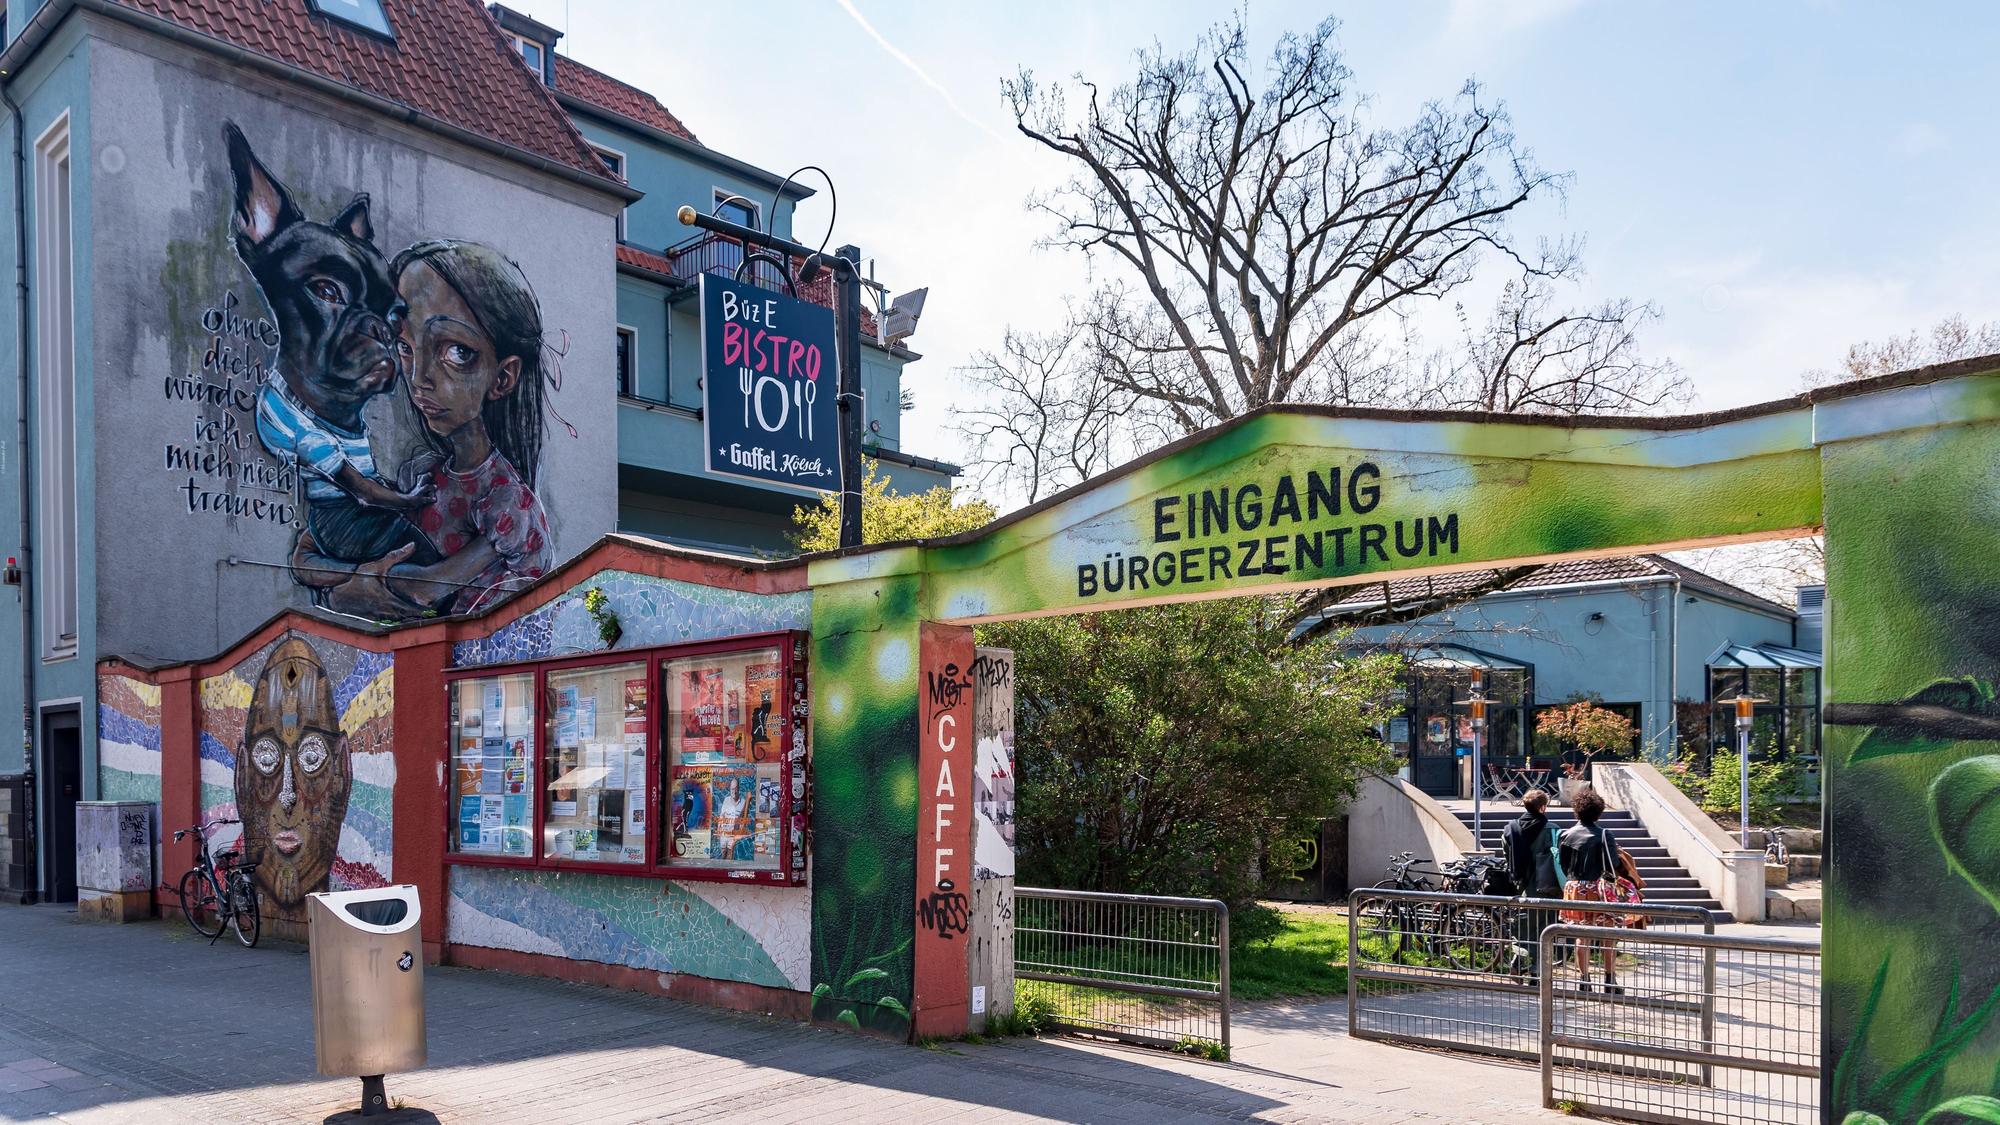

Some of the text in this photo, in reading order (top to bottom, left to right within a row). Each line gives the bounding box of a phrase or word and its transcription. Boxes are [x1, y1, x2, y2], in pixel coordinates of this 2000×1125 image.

[203, 289, 279, 348] ohne
[204, 337, 268, 385] dich
[723, 322, 821, 381] BISTRO
[165, 374, 257, 412] würde
[195, 409, 251, 449] ich
[166, 443, 240, 479] mich
[730, 442, 824, 477] Gaffel Kölsch
[1154, 462, 1381, 543] EINGANG
[1078, 513, 1459, 598] BÜRGERZENTRUM
